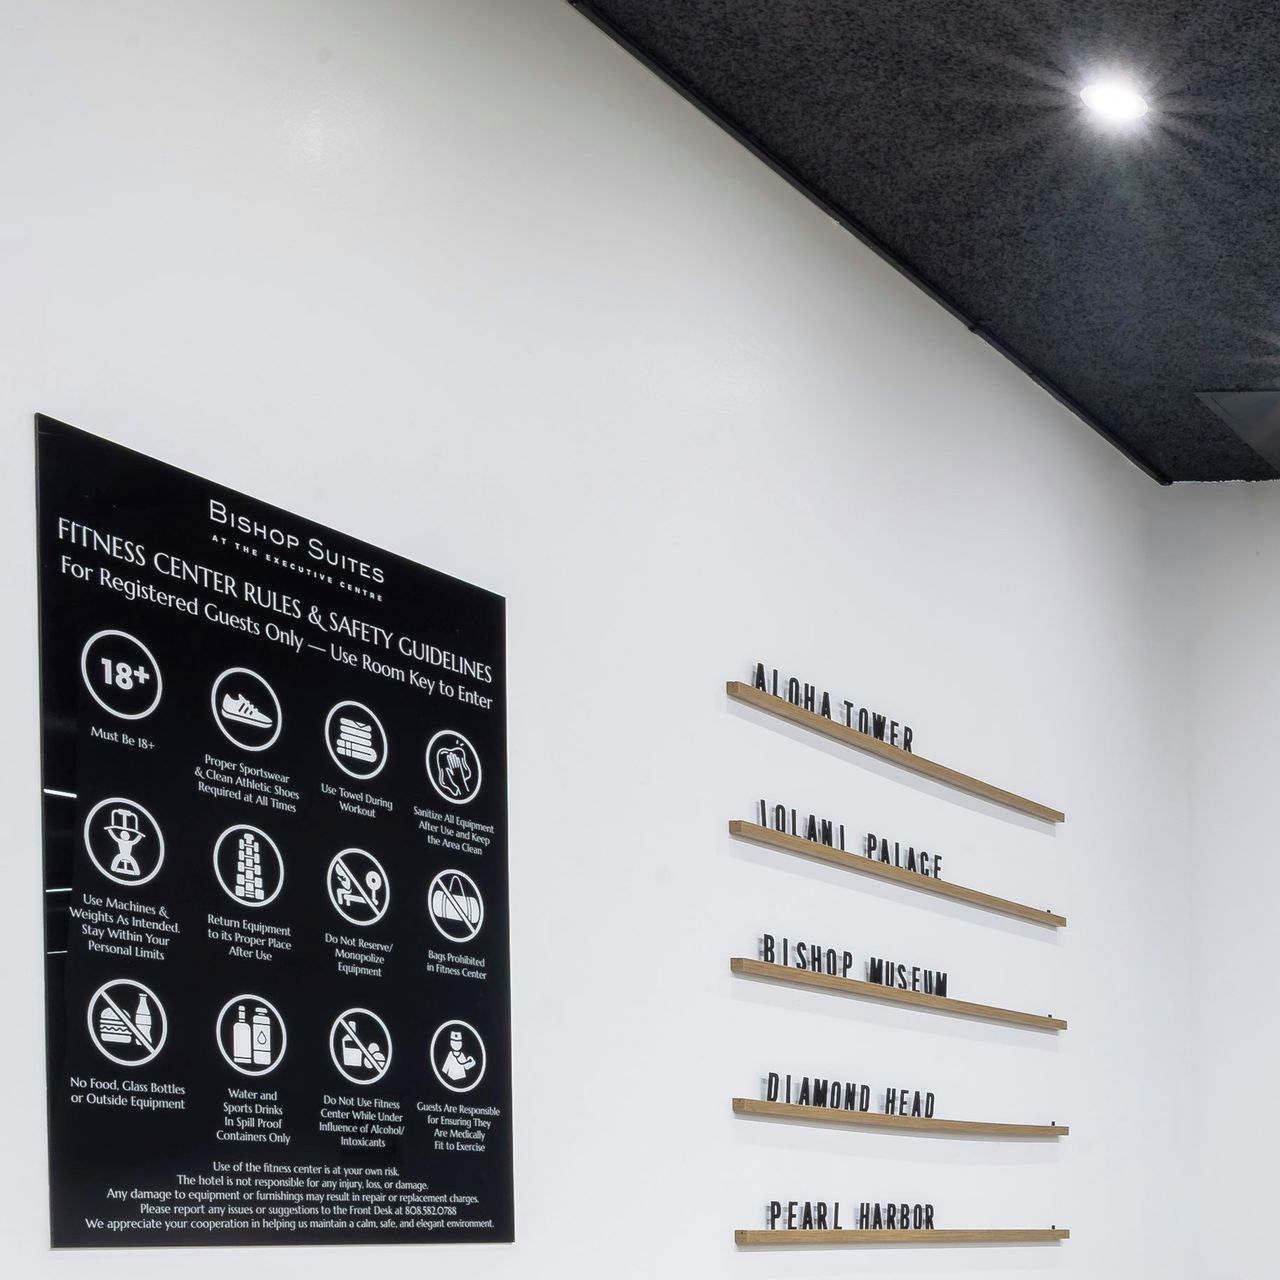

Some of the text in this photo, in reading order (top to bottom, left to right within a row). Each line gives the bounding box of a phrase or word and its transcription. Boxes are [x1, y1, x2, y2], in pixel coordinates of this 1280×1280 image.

[211, 534, 382, 601] AT THE EXECUTIVE CENTRE
[58, 516, 492, 683] FITNESS CENTER RULES & SAFETY GUIDELINES
[61, 554, 493, 709] For Registered Guests Only Use Room Key to Enter
[100, 657, 149, 690] 18+
[755, 662, 913, 753] ALOHA TOWER
[90, 725, 154, 749] Must Be 18+
[204, 753, 290, 783] Proper Sportswear
[194, 766, 299, 799] & Clean Athletic Shoes
[198, 781, 296, 812] Required at All Times
[321, 782, 392, 811] Use Towel During
[338, 800, 375, 818] Workout
[760, 799, 942, 880] IOLANI PALACE
[68, 906, 113, 923] Weights
[116, 914, 129, 925] As
[82, 893, 169, 919] Use Machines &
[81, 923, 169, 945] Stay Within Your
[207, 913, 291, 936] Return Equipment
[207, 928, 291, 949] to its Proper Place
[324, 932, 338, 943] Do
[340, 935, 355, 946] Not
[88, 939, 164, 960] Personal Limits
[228, 945, 272, 960] After Use
[334, 948, 384, 964] Monopolize
[337, 961, 381, 976] Equipment
[763, 933, 947, 998] BISHOP MUSEUM
[70, 1076, 87, 1087] No
[121, 1080, 148, 1092] Glass
[150, 1082, 185, 1094] Bottles
[227, 1087, 277, 1100] Water and
[766, 1072, 935, 1119] DIAMOND HEAD
[70, 1092, 184, 1110] or Outside Equipment
[223, 1101, 283, 1115] Sports Drinks
[224, 1116, 282, 1129] In Spill Proof
[215, 1129, 290, 1145] Containers Only
[212, 1160, 230, 1171] Use
[232, 1161, 243, 1171] of
[245, 1162, 261, 1172] the
[263, 1162, 291, 1173] fitness
[293, 1164, 322, 1173] center
[324, 1164, 330, 1174] is
[332, 1165, 341, 1174] at
[343, 1167, 363, 1176] your
[176, 1174, 196, 1185] The
[198, 1175, 224, 1185] hotel
[226, 1175, 233, 1185] is
[235, 1176, 251, 1186] not
[254, 1176, 304, 1189] responsible
[306, 1177, 319, 1187] for
[321, 1180, 337, 1190] any
[383, 1181, 393, 1189] or
[140, 1202, 170, 1214] Please
[173, 1204, 205, 1216] report
[207, 1206, 225, 1216] any
[227, 1204, 253, 1214] issues
[255, 1206, 266, 1214] or
[268, 1204, 319, 1216] suggestions
[320, 1205, 331, 1214] to
[332, 1205, 347, 1214] the
[349, 1205, 371, 1214] Front
[373, 1205, 393, 1214] Desk
[394, 1206, 403, 1215] at
[770, 1201, 934, 1230] PEARL HARBOR
